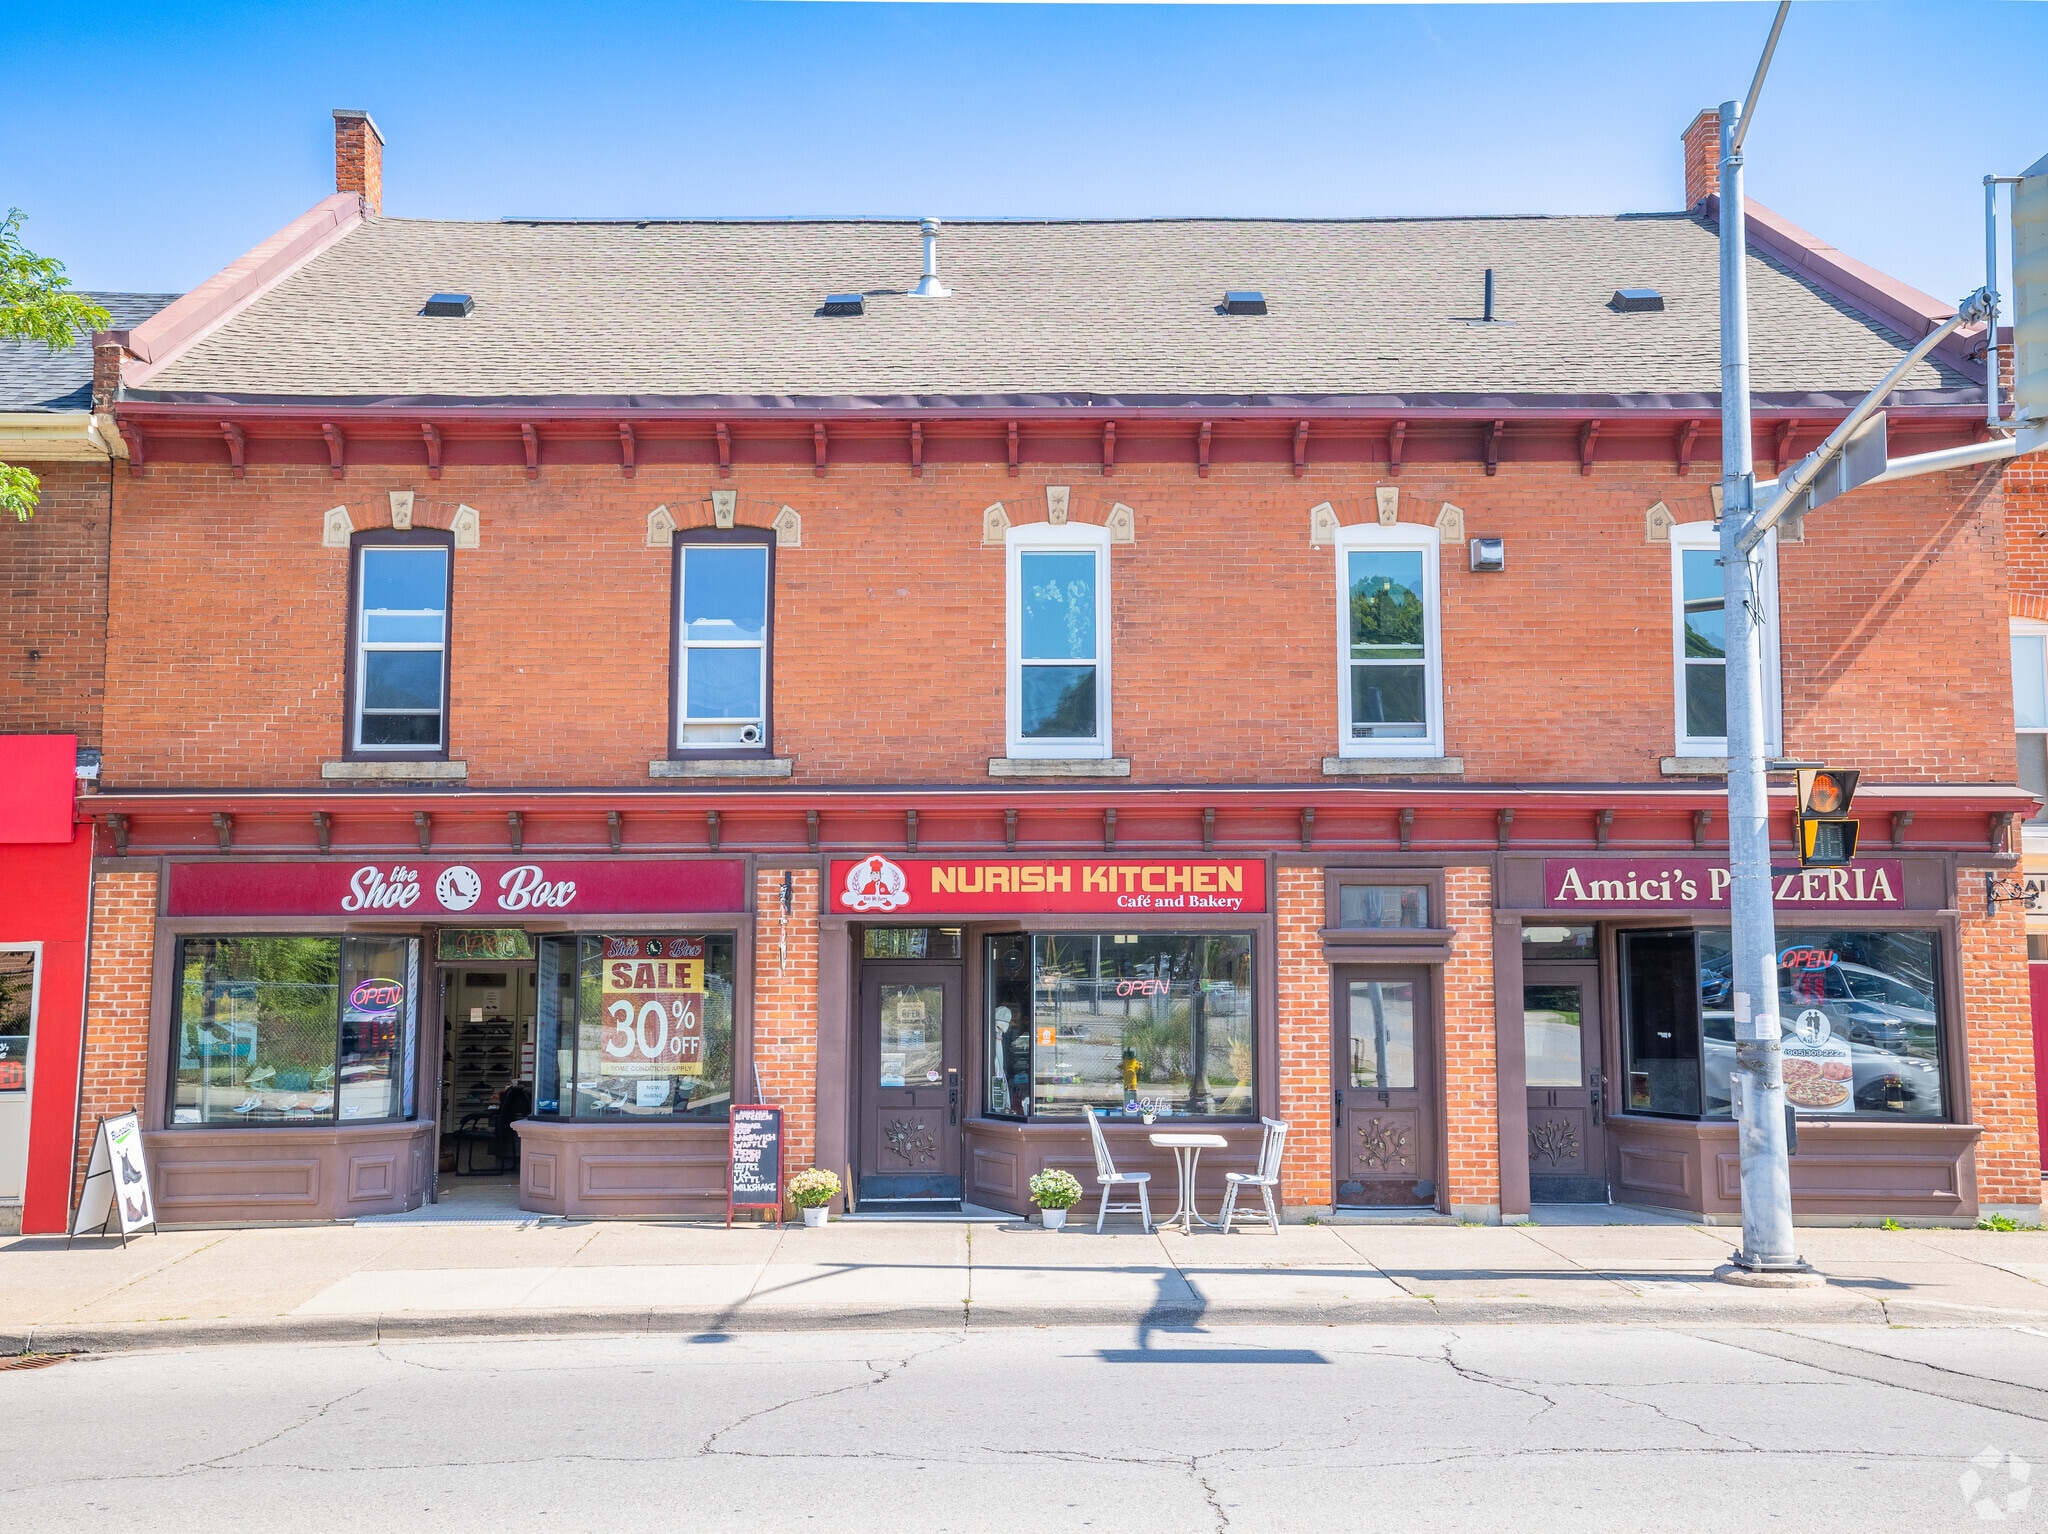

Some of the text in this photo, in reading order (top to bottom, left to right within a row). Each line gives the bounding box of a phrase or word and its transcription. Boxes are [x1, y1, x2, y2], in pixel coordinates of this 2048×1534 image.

[389, 865, 418, 882] the
[931, 866, 1243, 893] NURISH KITCHEN
[341, 865, 577, 911] Shoe Box
[1554, 867, 1897, 901] Amici's PZERIA
[1117, 895, 1243, 910] Café and Bakery
[608, 939, 701, 957] Shoe Box
[1782, 950, 1834, 968] OPEN
[611, 962, 692, 989] SALE
[353, 986, 401, 1005] OPEN
[1116, 979, 1170, 997] OPEN
[669, 1036, 700, 1055] OFF
[1140, 1096, 1171, 1113] Coffee
[733, 1141, 767, 1149] WAFFLE
[734, 1162, 759, 1171] COFFEE
[734, 1183, 776, 1192] MILKSHAKE
